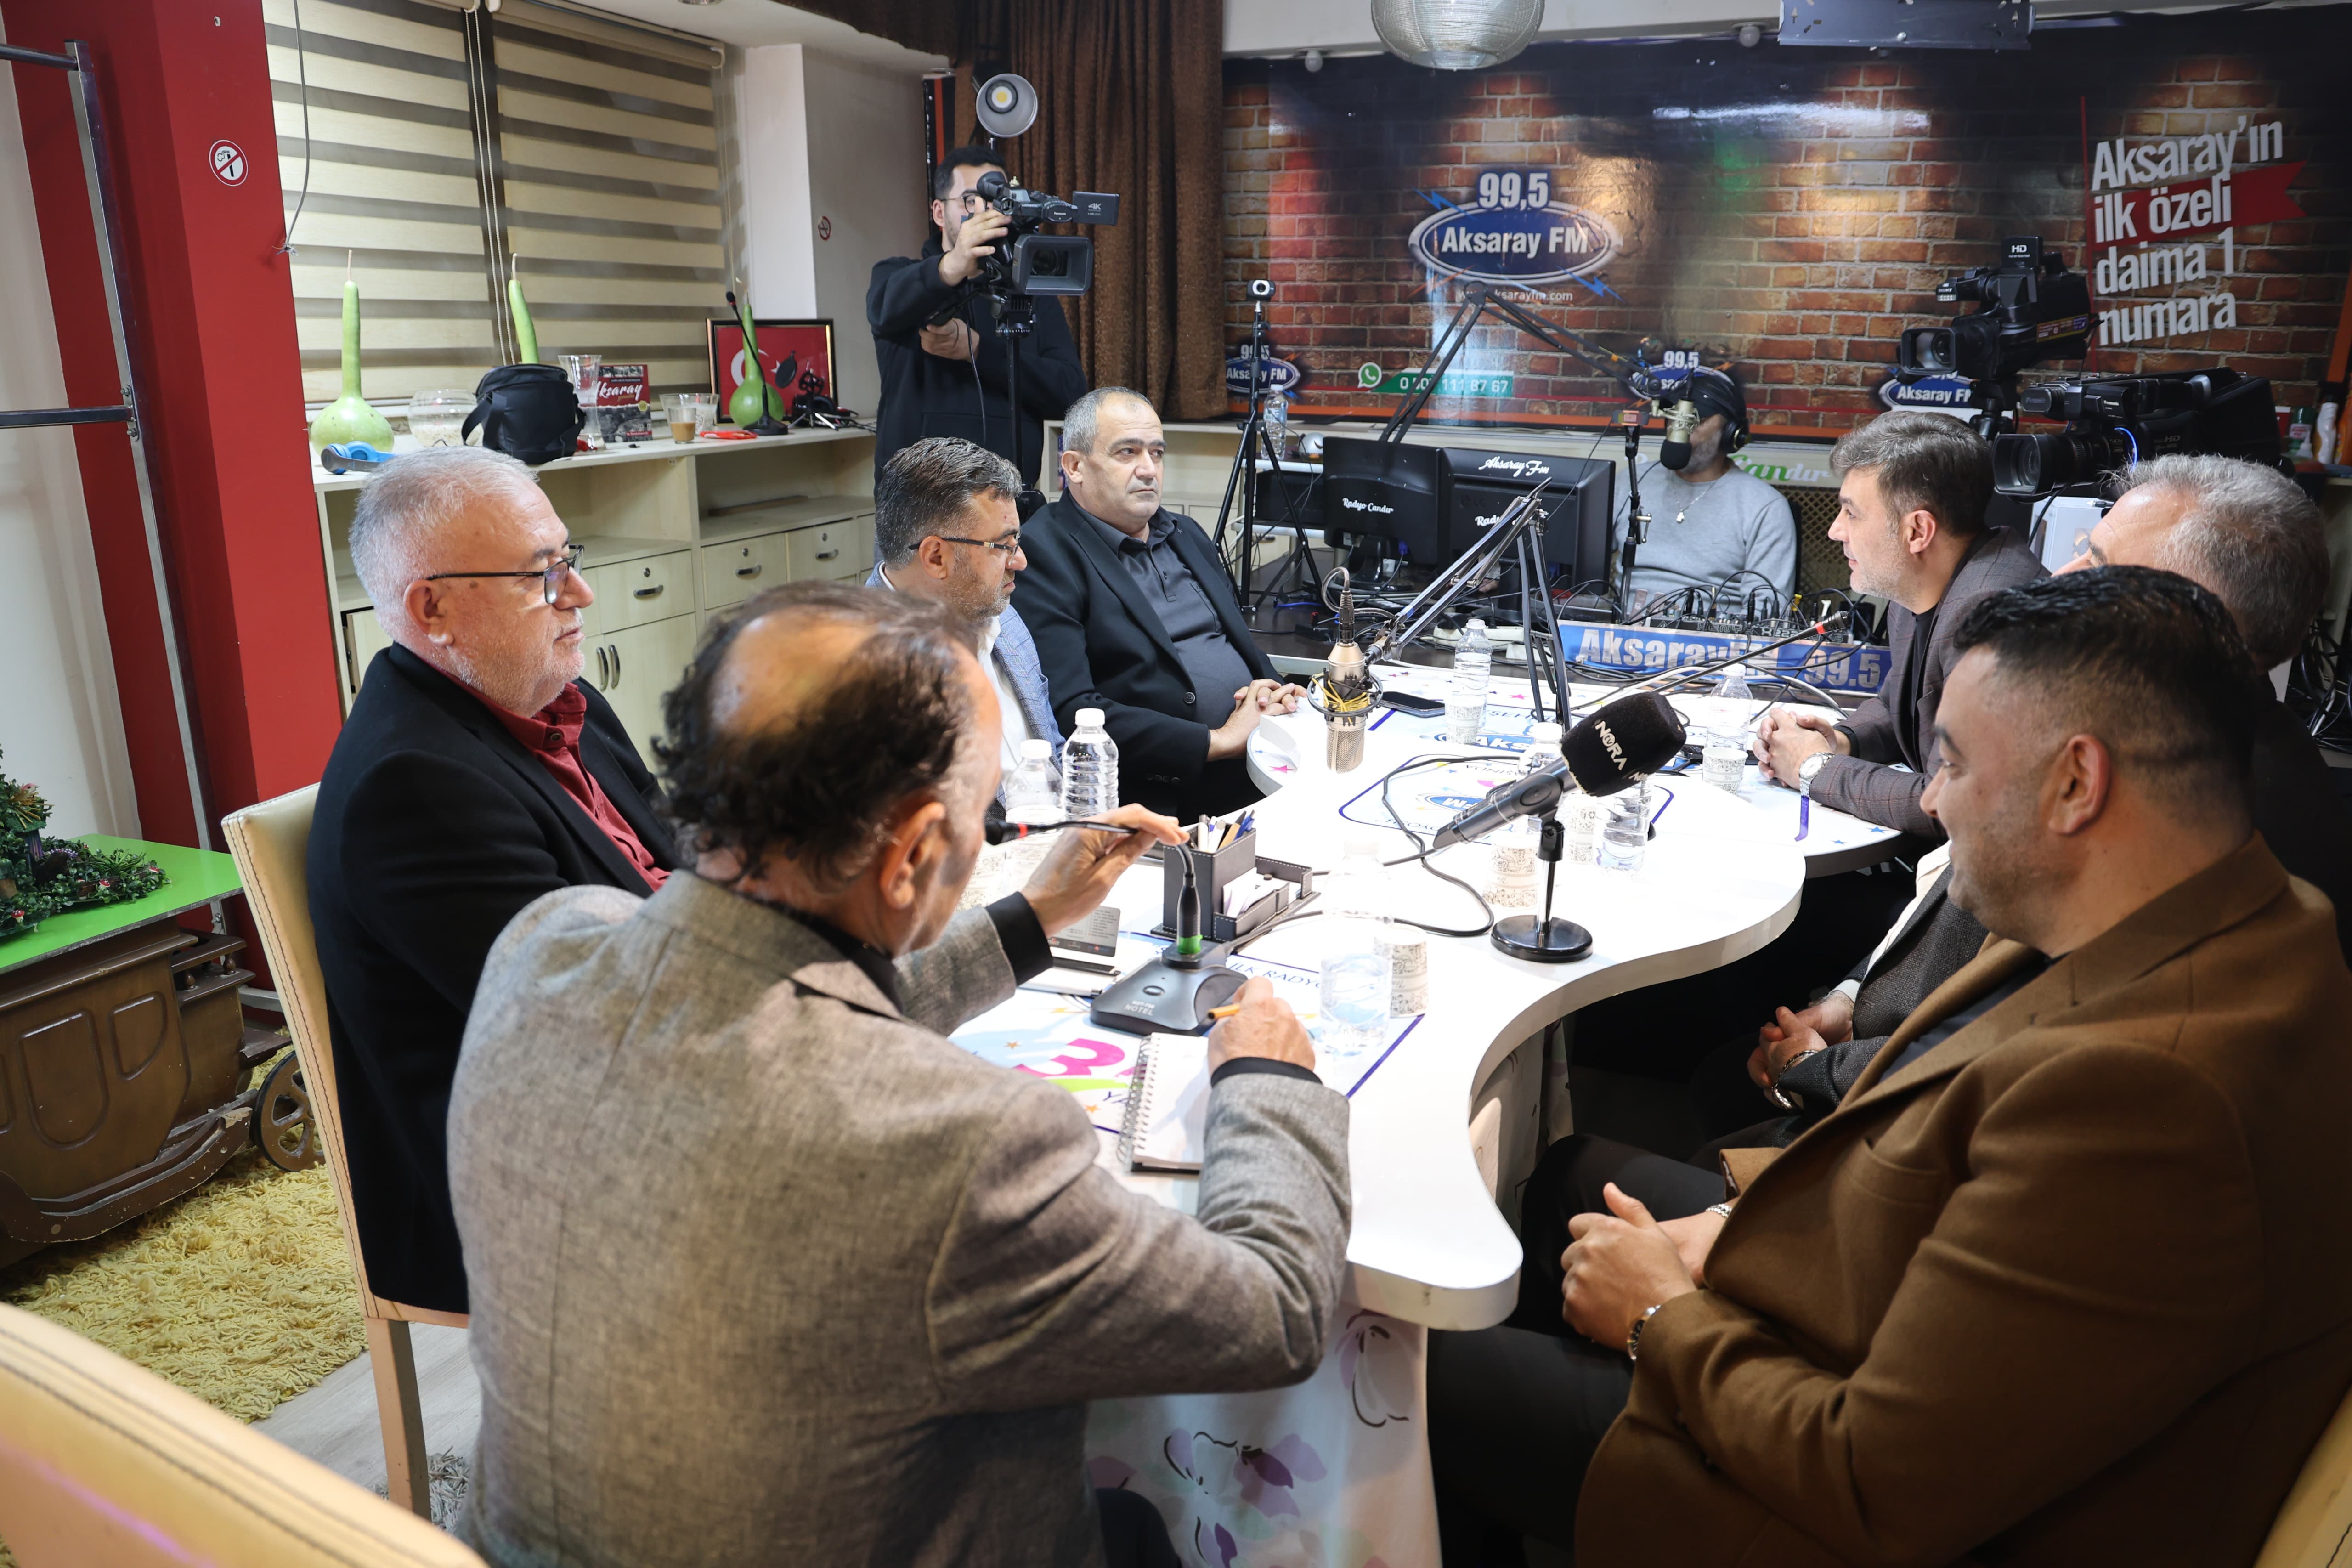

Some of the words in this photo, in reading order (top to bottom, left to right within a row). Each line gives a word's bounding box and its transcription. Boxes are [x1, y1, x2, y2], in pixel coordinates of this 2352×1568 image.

[1479, 172, 1549, 211] 99,5
[2094, 192, 2137, 243] ilk
[2148, 173, 2232, 234] özeli
[1441, 227, 1541, 259] Aksaray
[1549, 227, 1589, 253] FM
[2012, 244, 2027, 253] HD
[2096, 241, 2207, 294] daima
[2218, 226, 2234, 275] 1
[2098, 292, 2237, 346] numara
[1271, 368, 1286, 380] FM
[1663, 351, 1699, 370] 99,5
[1896, 385, 1952, 404] Aksaray
[1478, 456, 1525, 478] Aksaray
[1525, 460, 1550, 476] Fm
[1342, 498, 1367, 511] Radyo
[1367, 502, 1394, 514] Candır
[1802, 645, 1881, 687] 99.5
[1595, 721, 1627, 770] NORA
